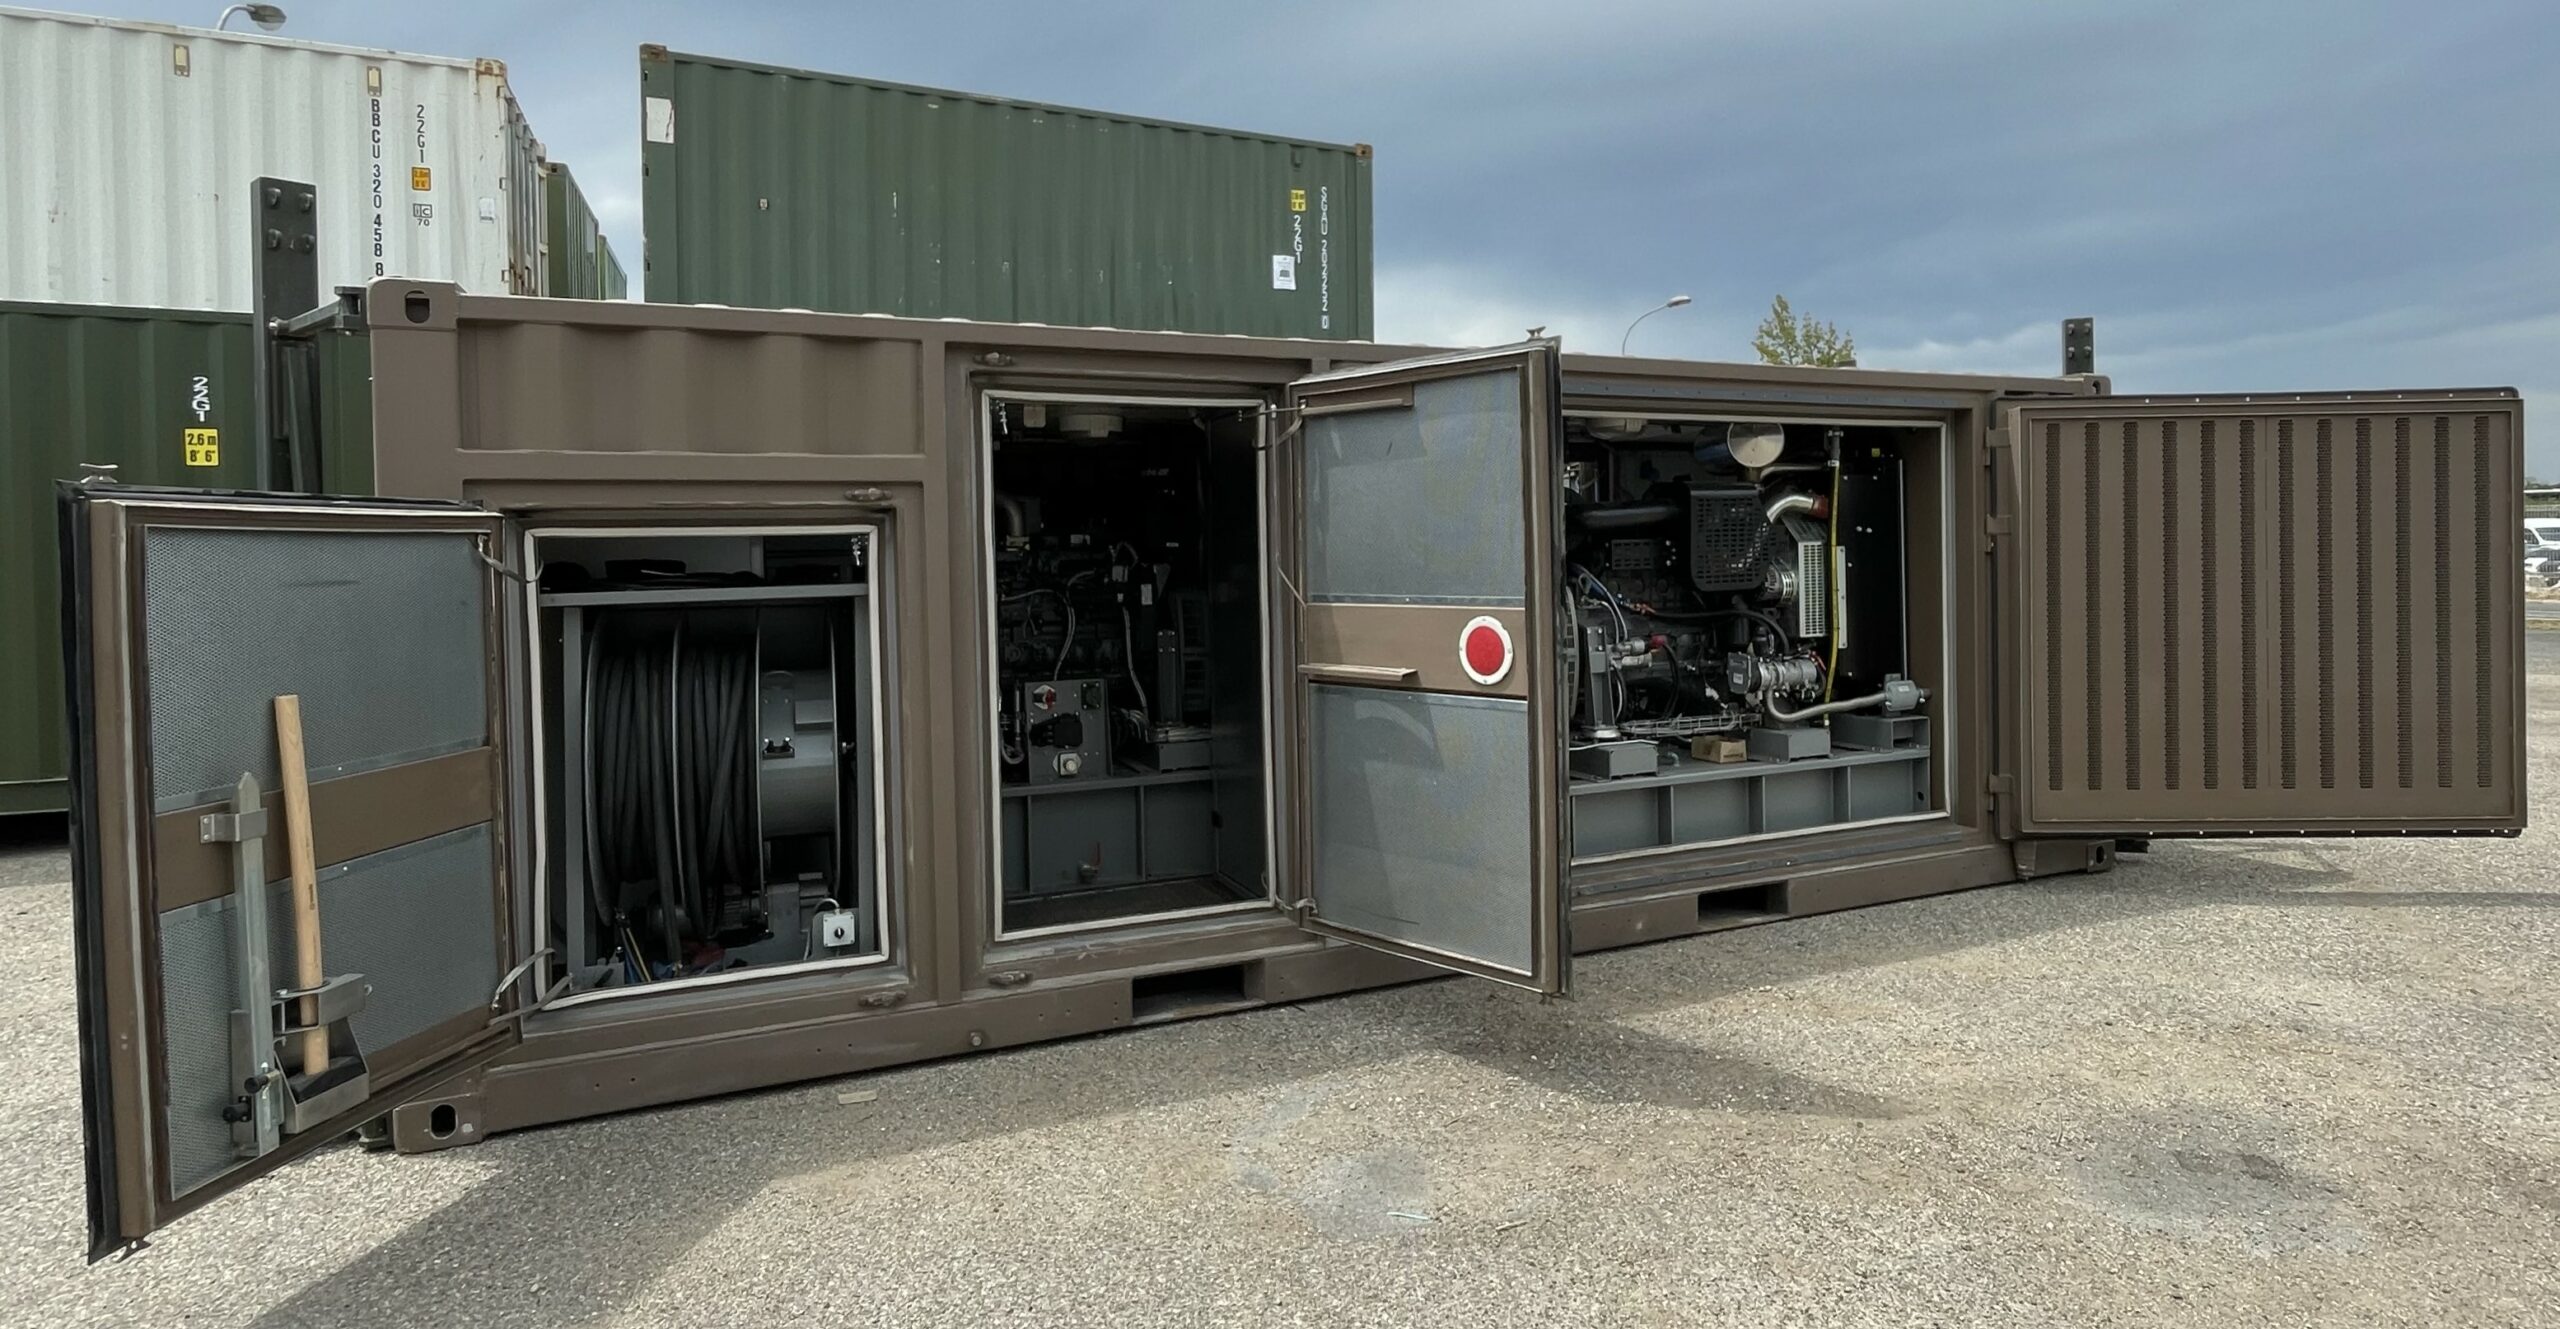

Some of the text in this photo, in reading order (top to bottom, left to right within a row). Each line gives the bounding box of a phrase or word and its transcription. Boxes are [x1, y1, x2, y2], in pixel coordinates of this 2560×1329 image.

[416, 104, 426, 163] 22G1
[371, 98, 384, 277] BBCU 320 458 8
[1320, 186, 1328, 236] SGAU
[417, 218, 431, 227] 70
[1293, 214, 1303, 264] 22G1
[191, 376, 211, 422] 22G1
